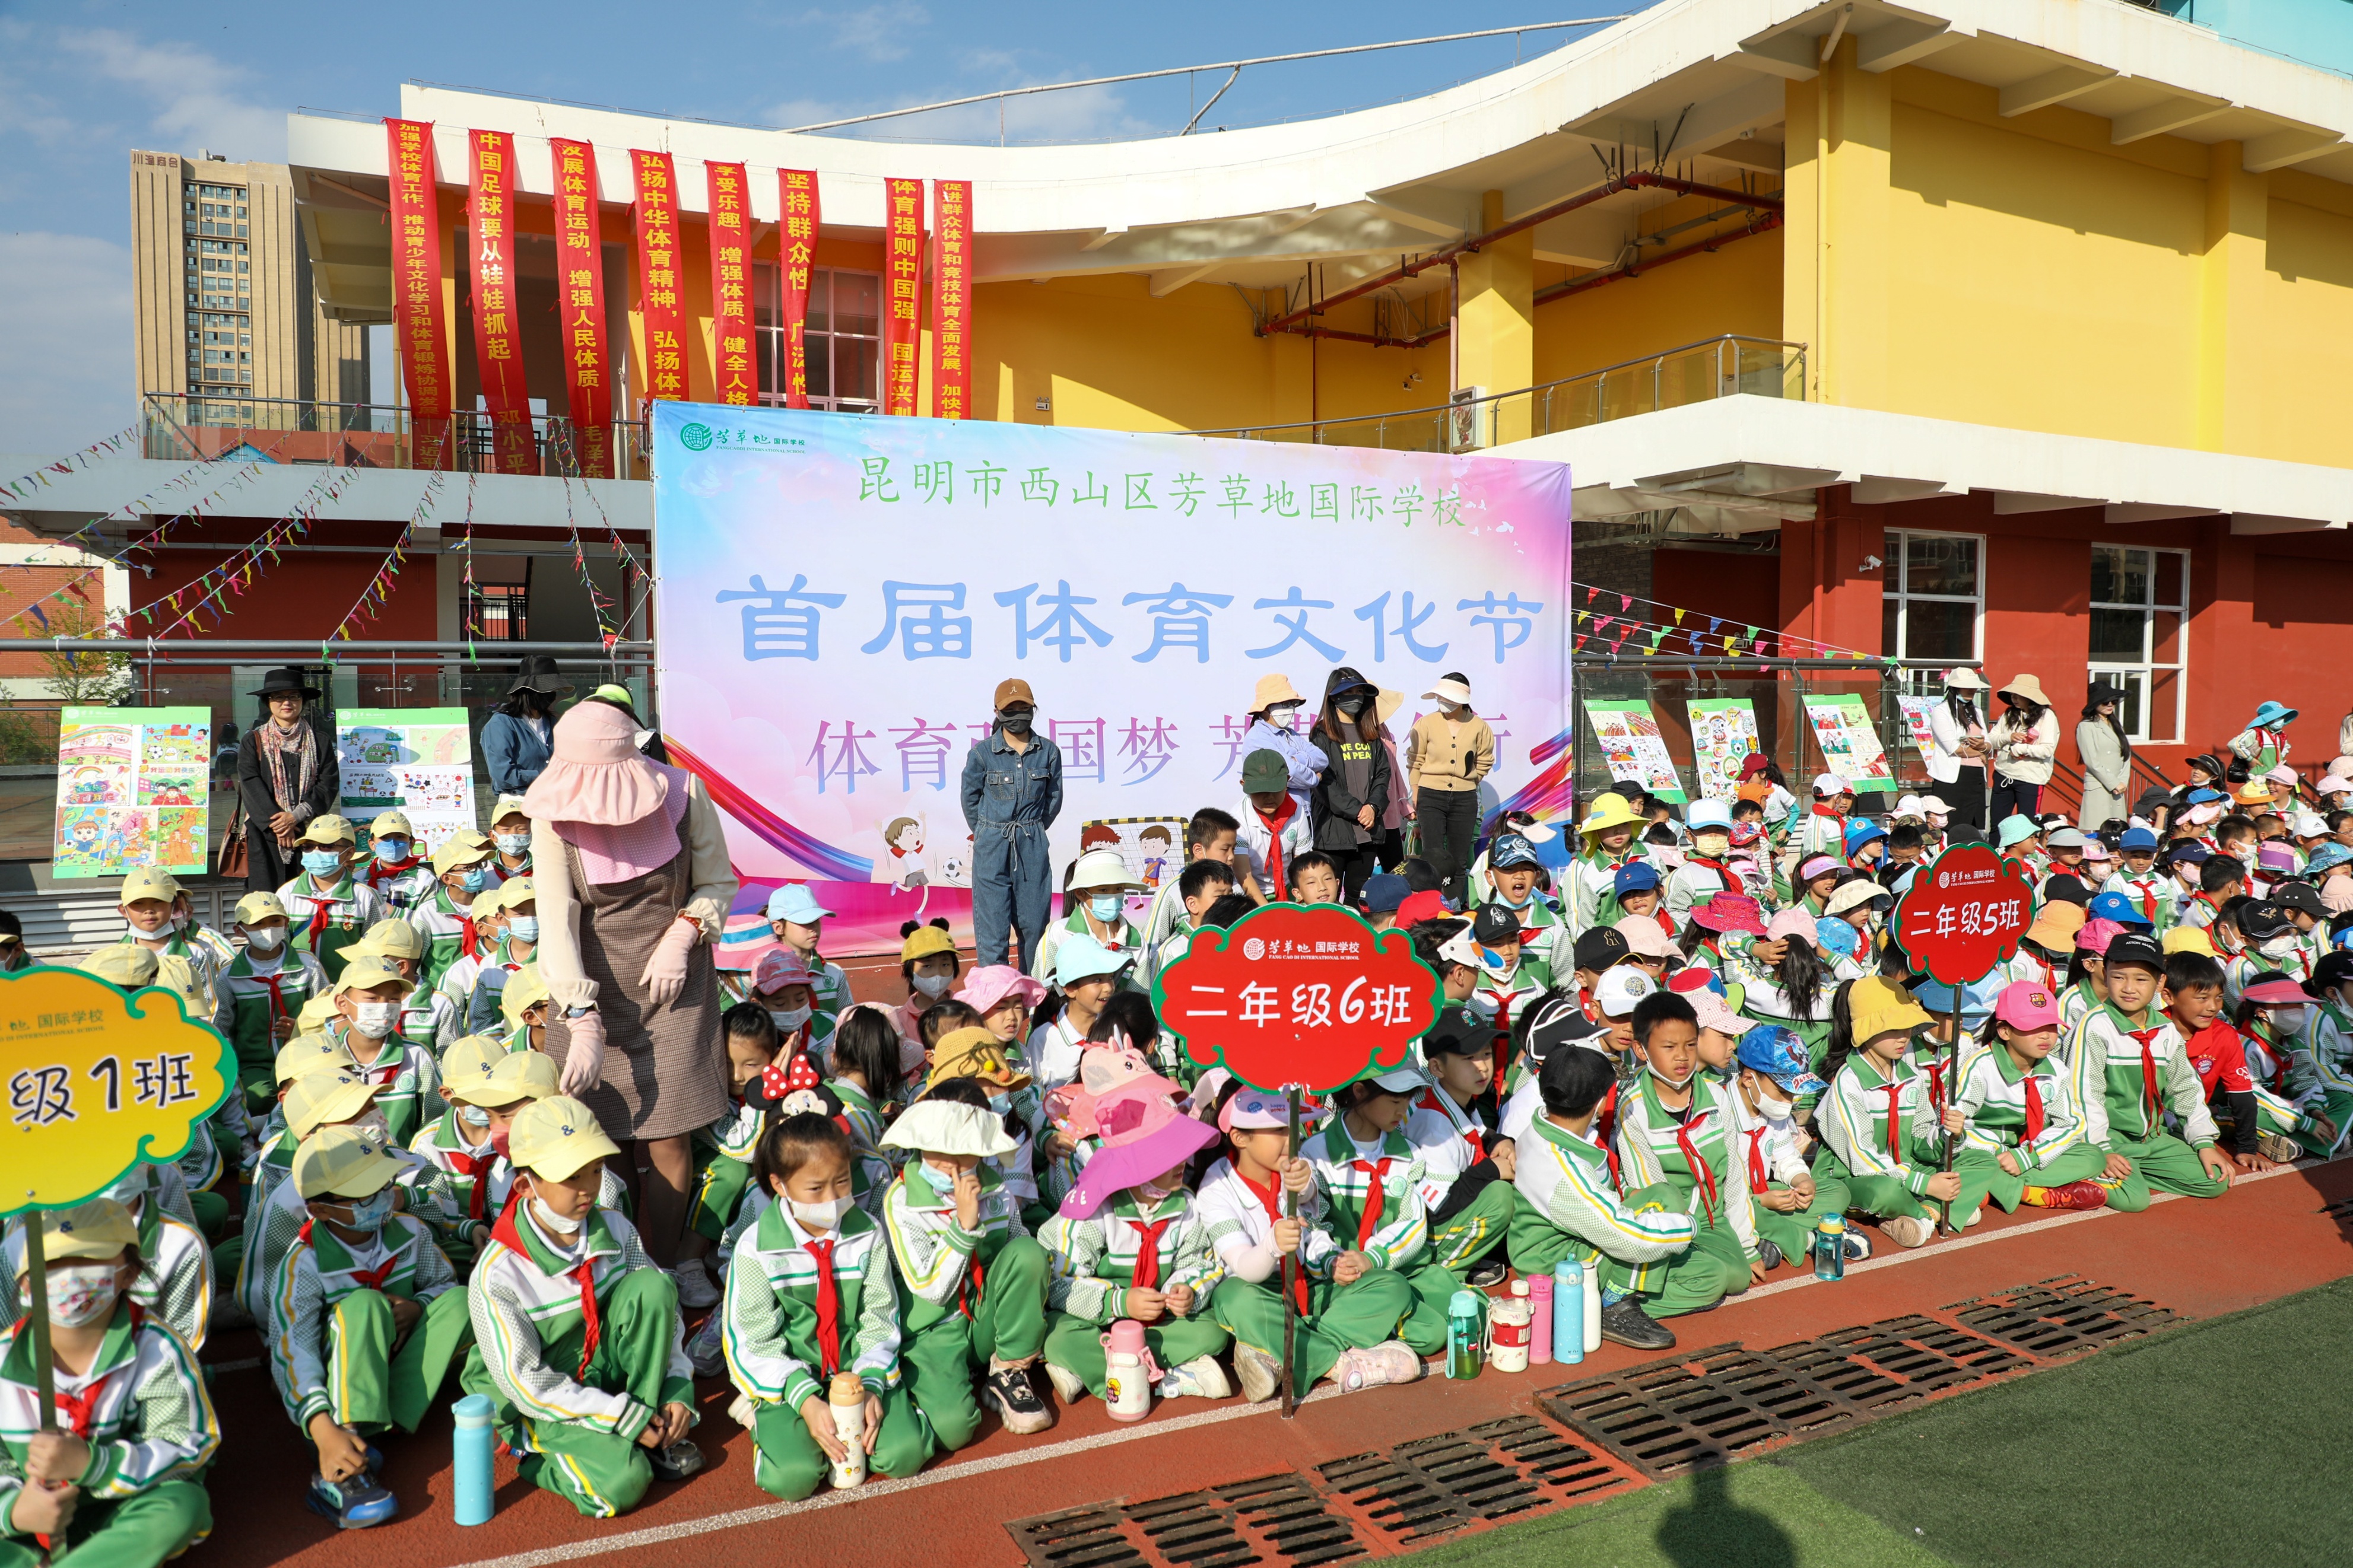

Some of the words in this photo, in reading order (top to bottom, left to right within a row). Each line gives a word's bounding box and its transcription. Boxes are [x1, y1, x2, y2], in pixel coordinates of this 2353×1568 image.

[858, 456, 1466, 527] 昆明市西山区芳草地国际学校
[717, 573, 1544, 664] 首届体育文化节
[805, 716, 1180, 794] 体育国梦
[1911, 899, 2020, 939] 二年级5班
[1186, 975, 1411, 1028] 二年级6班
